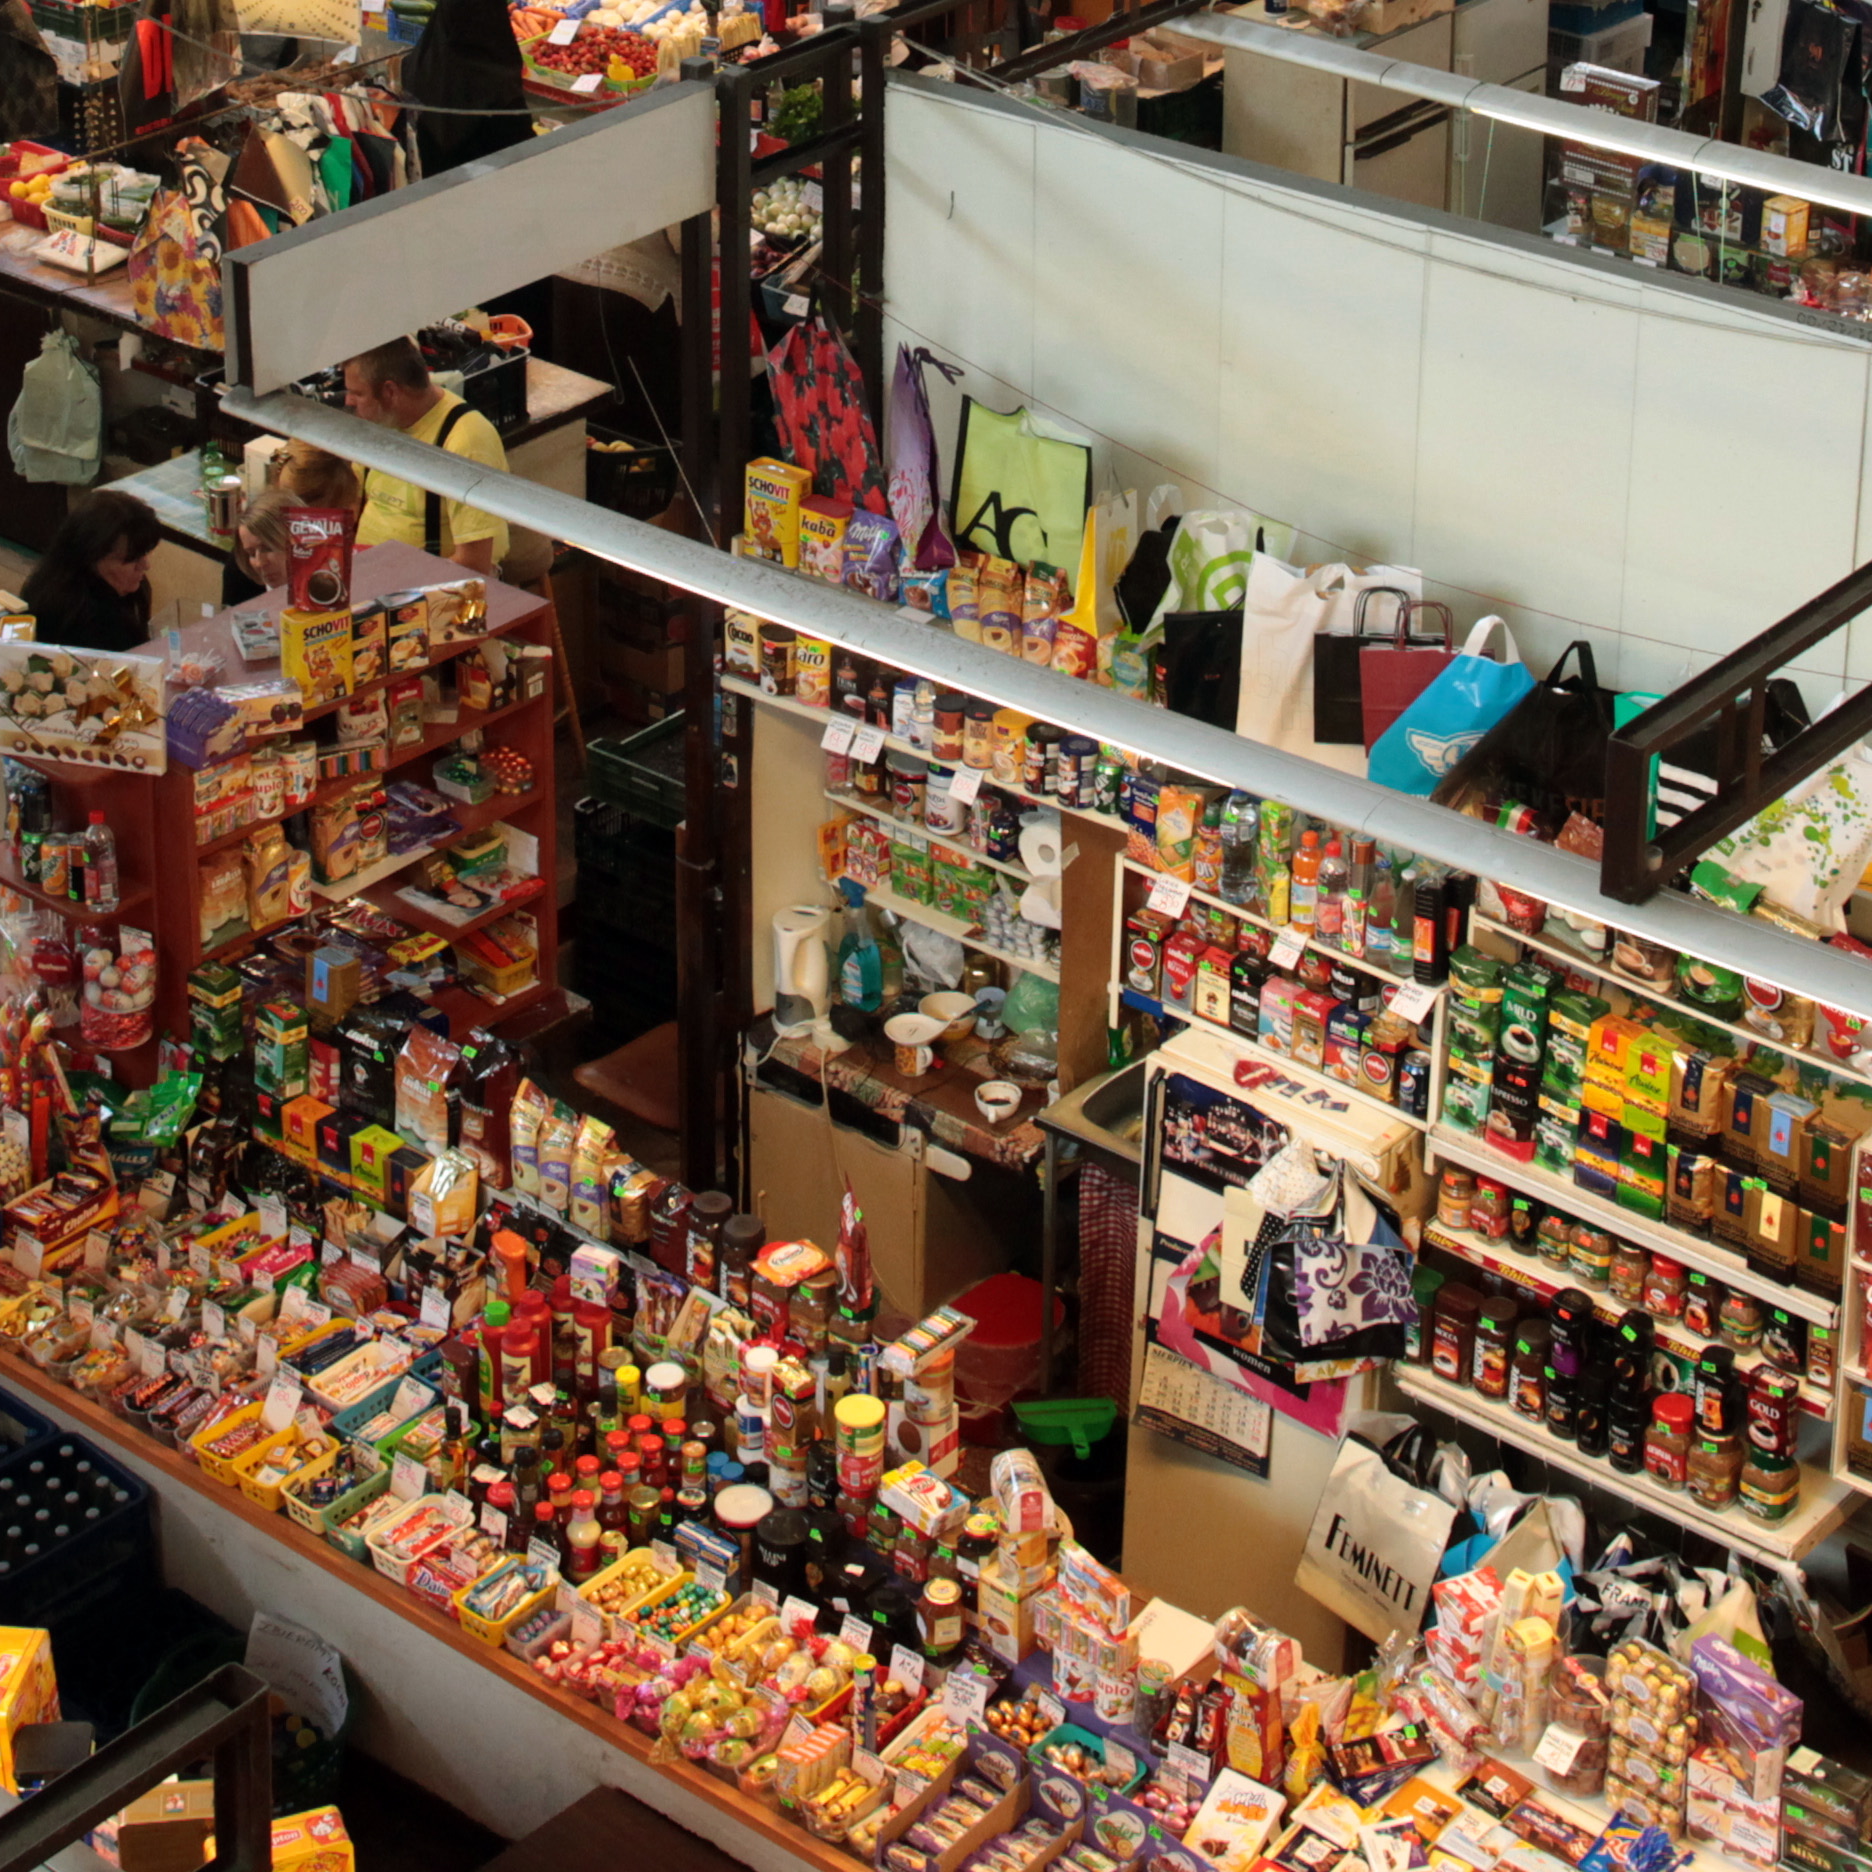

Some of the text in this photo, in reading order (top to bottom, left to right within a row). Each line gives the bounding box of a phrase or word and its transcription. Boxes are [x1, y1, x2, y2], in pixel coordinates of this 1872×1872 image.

[748, 474, 791, 502] SCHOVIT
[801, 518, 835, 539] kaba
[302, 614, 350, 642] SCHOVIT
[1505, 999, 1537, 1023] MILD
[1497, 1263, 1540, 1289] Tchibo
[1232, 1343, 1273, 1375] women
[1749, 1396, 1781, 1420] GOLD
[1324, 1512, 1418, 1611] FEMINETT
